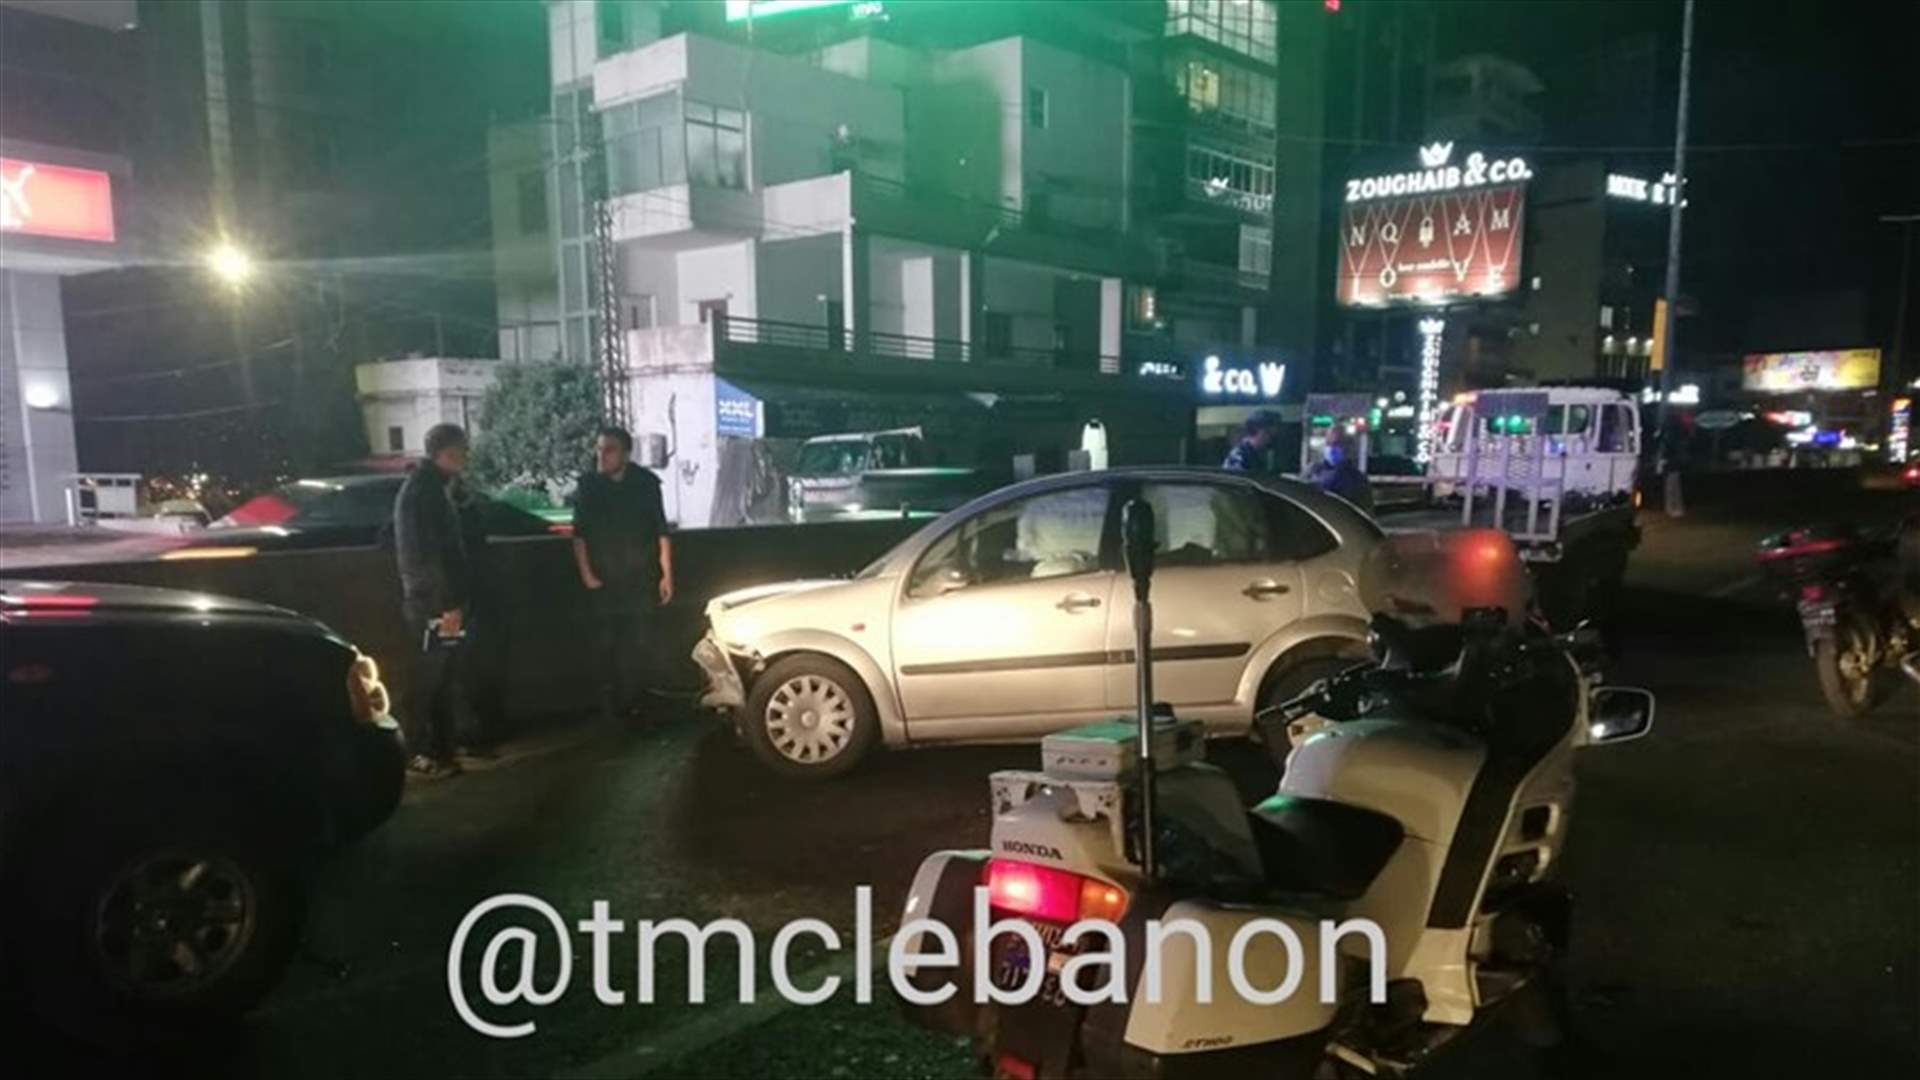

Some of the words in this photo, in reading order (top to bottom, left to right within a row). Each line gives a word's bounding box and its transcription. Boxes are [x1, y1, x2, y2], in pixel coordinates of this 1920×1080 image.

[1345, 167, 1461, 202] ZOUGHAIB
[1463, 151, 1488, 186] &
[1489, 157, 1533, 183] CO.
[1002, 841, 1063, 861] HONDA
